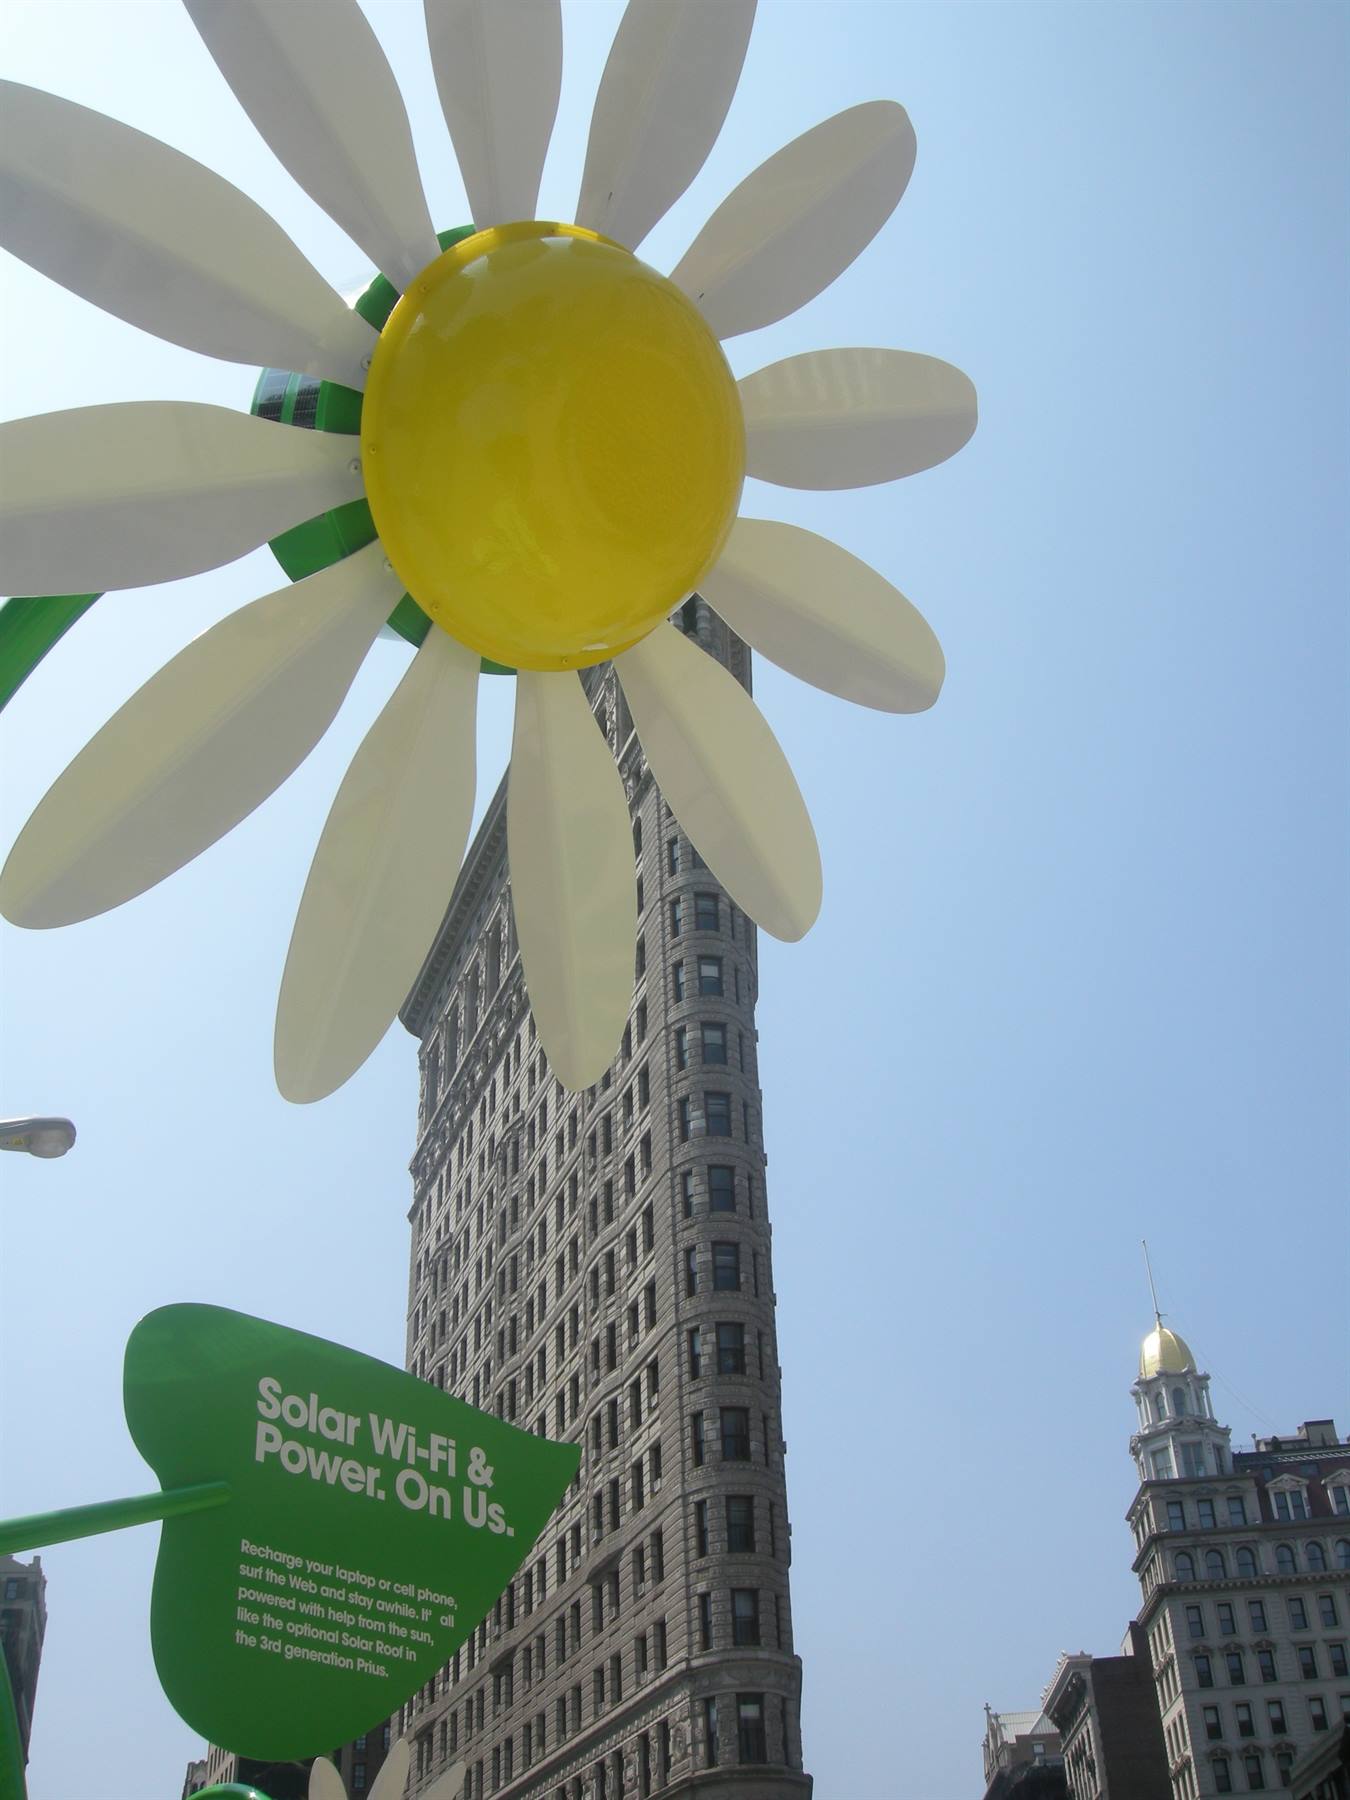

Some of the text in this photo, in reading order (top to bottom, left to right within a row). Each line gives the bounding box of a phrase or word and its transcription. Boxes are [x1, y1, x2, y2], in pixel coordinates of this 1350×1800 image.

[257, 1376, 494, 1488] Solar Wi-Fi &
[255, 1420, 515, 1537] Power. On Us.
[239, 1563, 264, 1580] surf
[265, 1568, 286, 1585] the
[289, 1574, 317, 1594] Web
[320, 1586, 345, 1602] and
[348, 1591, 374, 1610] stay
[376, 1600, 419, 1620] awhile.
[440, 1615, 454, 1627] all
[240, 1539, 458, 1610] Recharge your laptop or cell phone,
[237, 1606, 417, 1662] like the optional Solar Roof in
[238, 1587, 434, 1647] powered with help from the sun,
[235, 1629, 389, 1678] the 3rd generation Prius.
